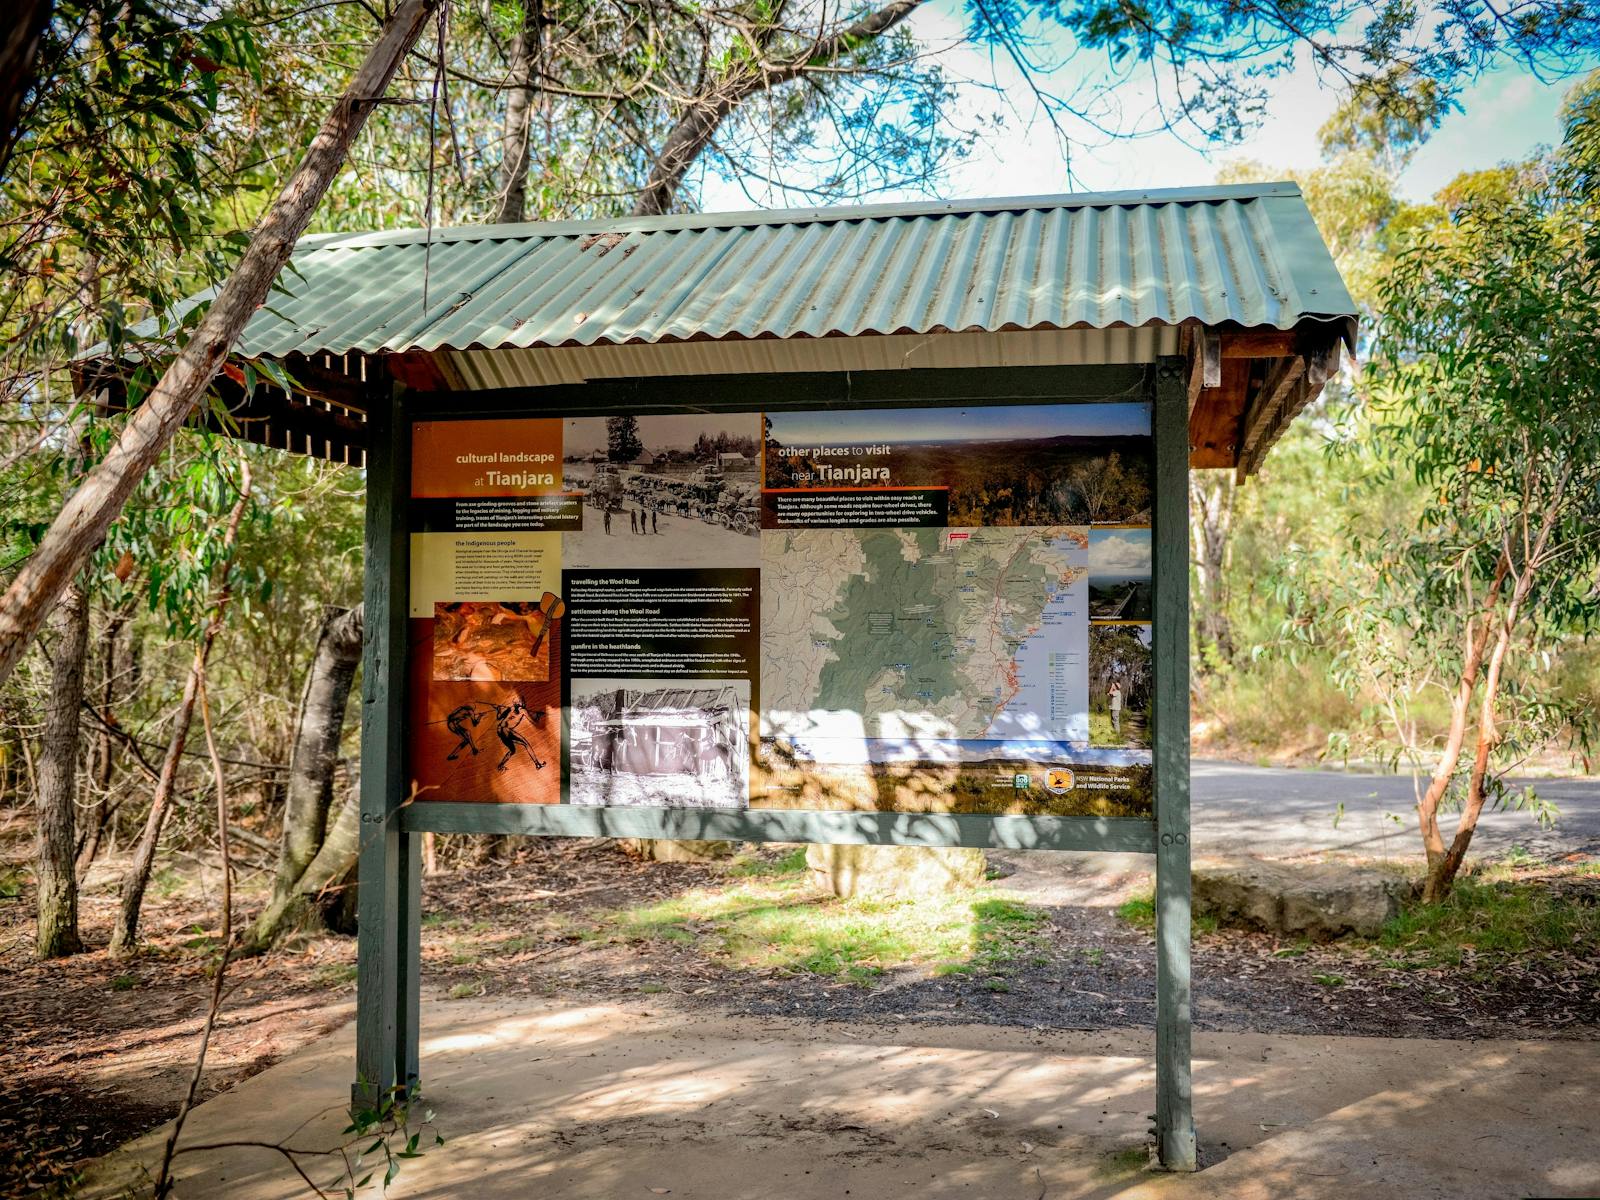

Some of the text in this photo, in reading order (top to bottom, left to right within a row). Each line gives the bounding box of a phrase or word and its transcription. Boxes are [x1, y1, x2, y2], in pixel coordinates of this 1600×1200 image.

[456, 452, 555, 464] cultural landscape
[778, 444, 890, 458] other places to visit
[474, 470, 554, 489] at Tianjara
[791, 464, 890, 484] near Tianjara
